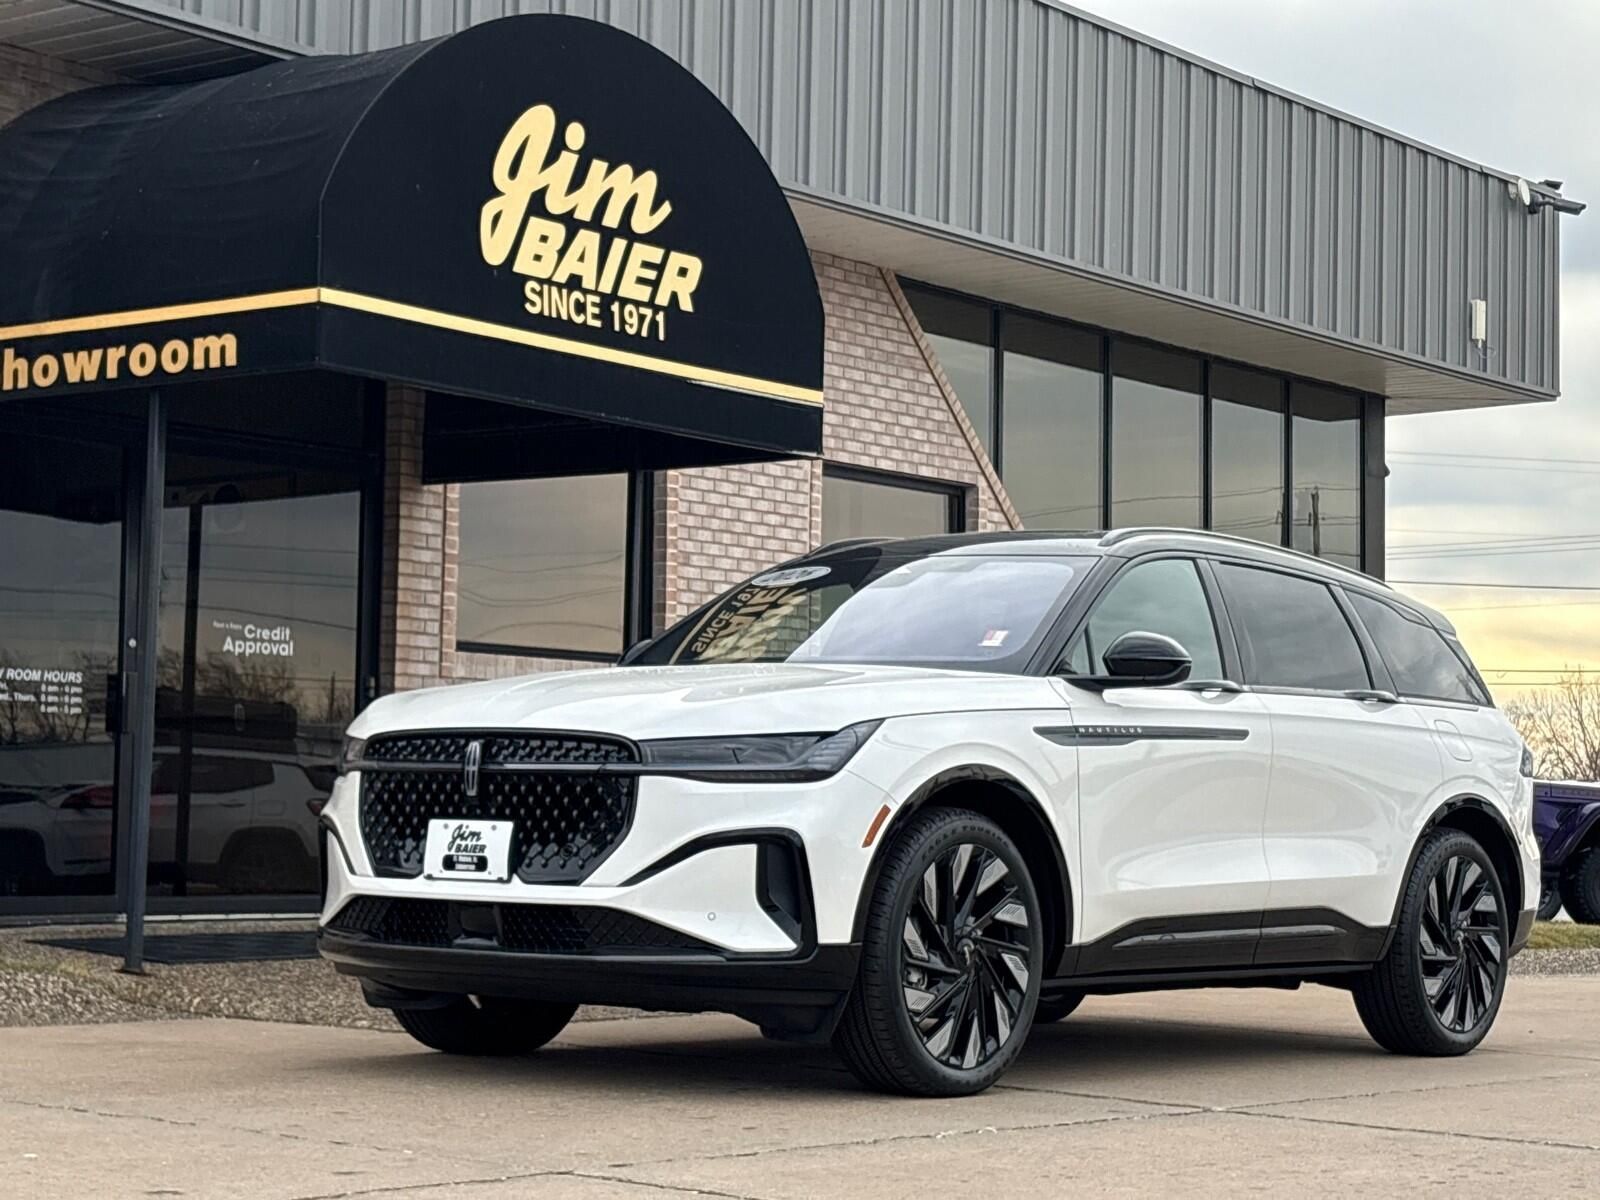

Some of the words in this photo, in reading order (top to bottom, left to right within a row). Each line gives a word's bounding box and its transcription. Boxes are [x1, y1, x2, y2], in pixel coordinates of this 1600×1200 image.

[480, 104, 672, 266] Jim
[512, 215, 703, 312] BAIER
[524, 280, 602, 328] SINCE
[610, 300, 665, 341] 1971
[2, 332, 238, 391] howroom
[244, 624, 291, 641] Credit
[222, 636, 294, 657] Approval
[6, 667, 42, 682] ROOM
[43, 670, 83, 684] HOURS
[1078, 726, 1143, 734] NAUTILUS
[448, 824, 482, 852] Jim
[454, 843, 487, 854] BAIER
